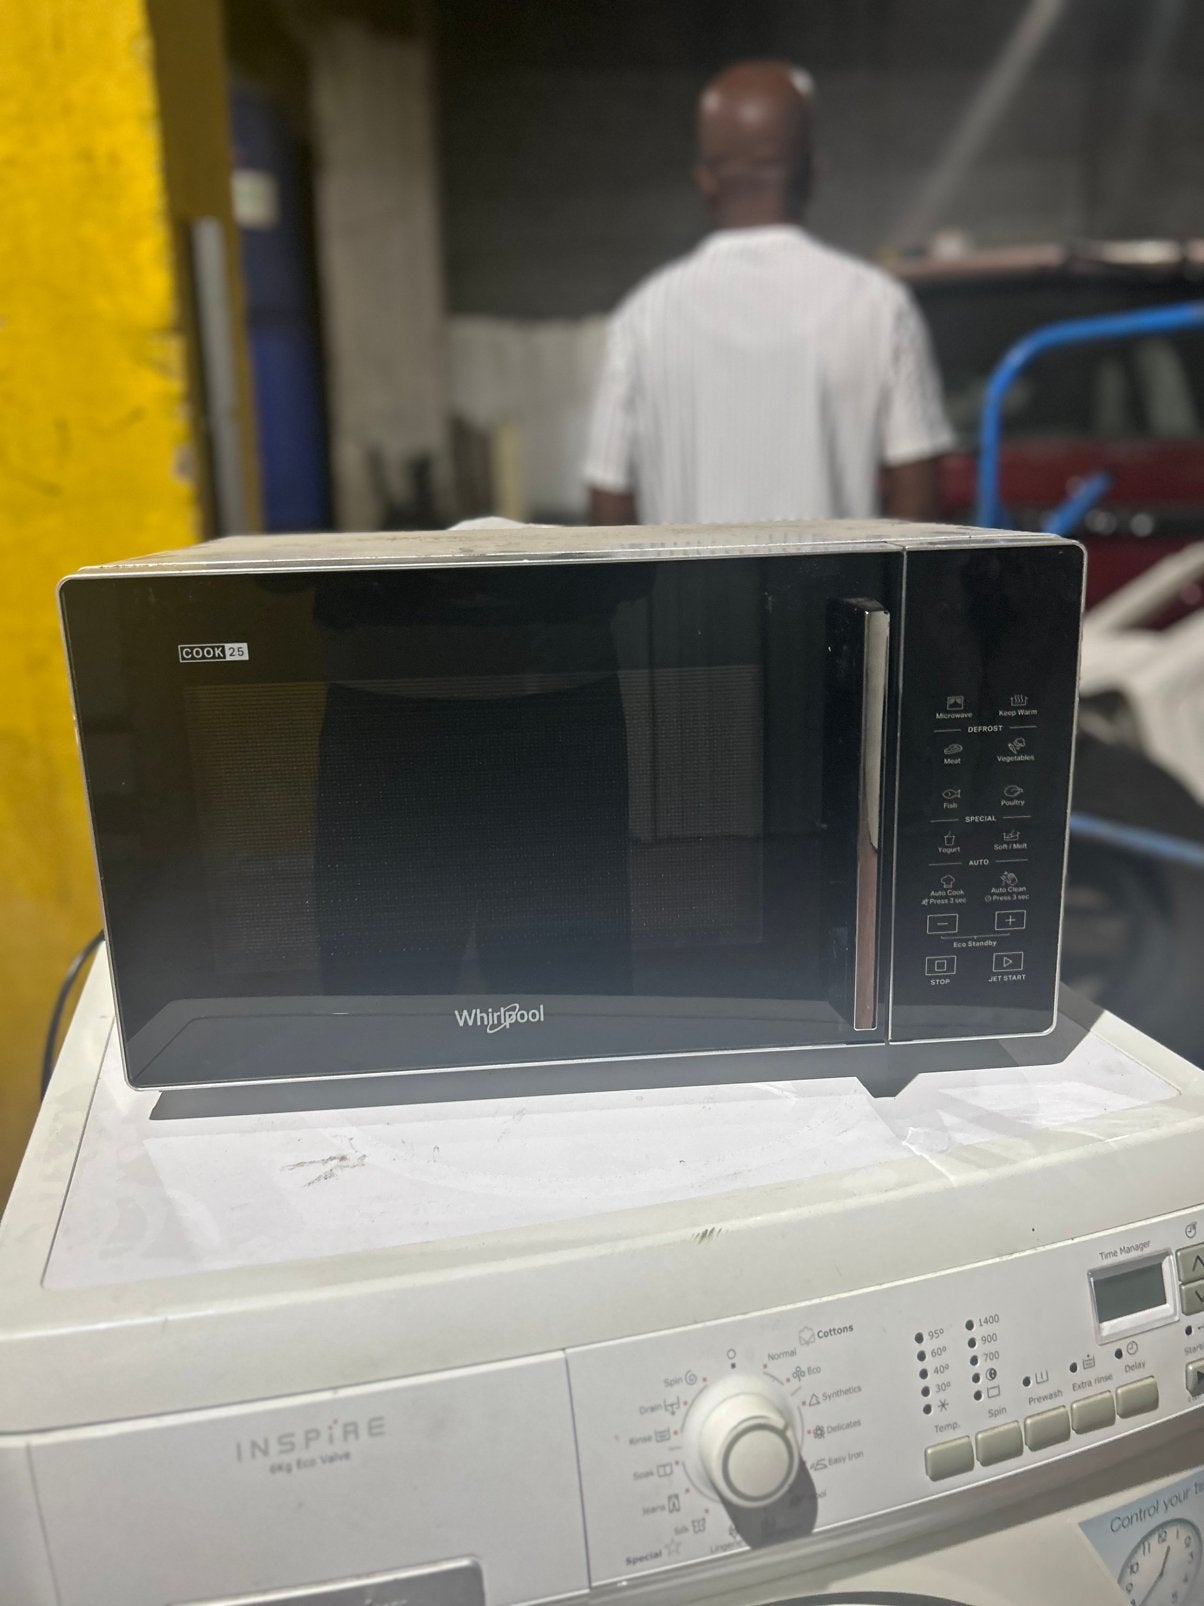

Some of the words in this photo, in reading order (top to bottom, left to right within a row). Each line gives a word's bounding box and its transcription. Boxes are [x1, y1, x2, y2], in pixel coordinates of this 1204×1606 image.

[182, 647, 224, 659] COOK
[228, 646, 244, 657] 25
[935, 711, 973, 720] Microwave
[998, 709, 1017, 717] Keep
[1018, 708, 1038, 716] Warm
[967, 725, 1004, 733] DEFROST
[997, 754, 1035, 763] Vegetables
[1001, 799, 1025, 807] Poultry
[965, 815, 997, 823] SPECIAL
[938, 846, 961, 855] Yogurt
[1013, 842, 1027, 850] Melt
[1008, 885, 1026, 893] Clean
[967, 939, 997, 947] Standby
[930, 978, 951, 986] STOP
[1003, 974, 1026, 982] START
[454, 1003, 544, 1033] Whirlpool
[1099, 1251, 1119, 1261] Time
[1119, 1240, 1151, 1255] Manager
[978, 1314, 1000, 1327] 1400
[817, 1324, 854, 1339] Cottons
[981, 1333, 998, 1345] 900
[767, 1348, 797, 1361] Normal
[983, 1351, 1000, 1362] 700
[807, 1366, 822, 1375] Eco
[1124, 1360, 1146, 1373] Delay
[663, 1377, 683, 1388] Spin
[1072, 1381, 1093, 1392] Extra
[1094, 1373, 1114, 1386] rinse
[822, 1384, 863, 1402] Synthetics
[1028, 1388, 1063, 1405] Prewash
[639, 1403, 662, 1415] Drain
[988, 1406, 1007, 1418] Spin
[826, 1418, 862, 1435] Delicates
[296, 1458, 317, 1469] Eco
[828, 1456, 846, 1467] Easy
[1110, 1501, 1160, 1533] Control
[1163, 1488, 1190, 1513] your
[625, 1549, 662, 1566] Special
